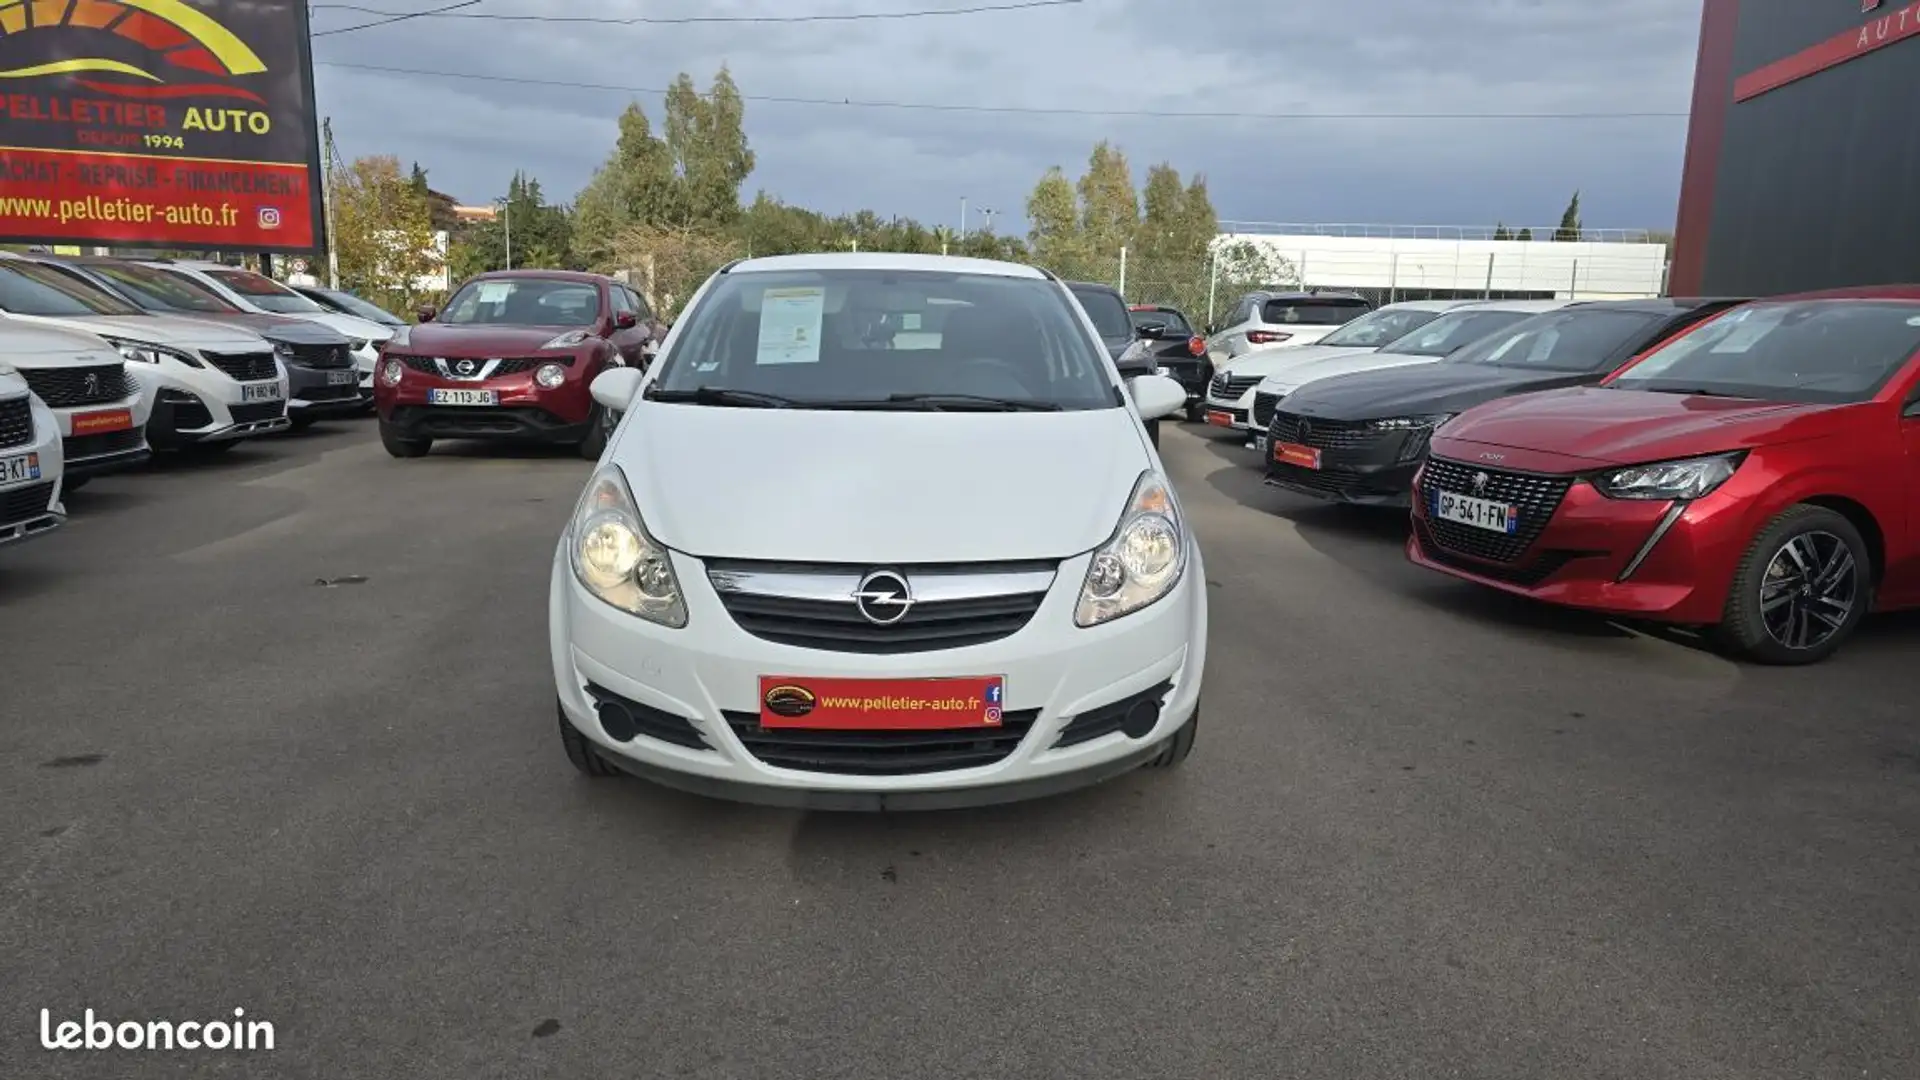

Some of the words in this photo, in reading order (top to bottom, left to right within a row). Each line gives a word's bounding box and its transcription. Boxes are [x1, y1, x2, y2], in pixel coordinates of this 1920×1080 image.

[182, 106, 270, 135] AUTO
[143, 134, 184, 149] 1994
[78, 161, 156, 190] REPRISE
[174, 168, 302, 196] FINANCEMENT
[1441, 495, 1506, 529] GP-541-FN
[820, 695, 981, 712] www.pelletier-auto.fr
